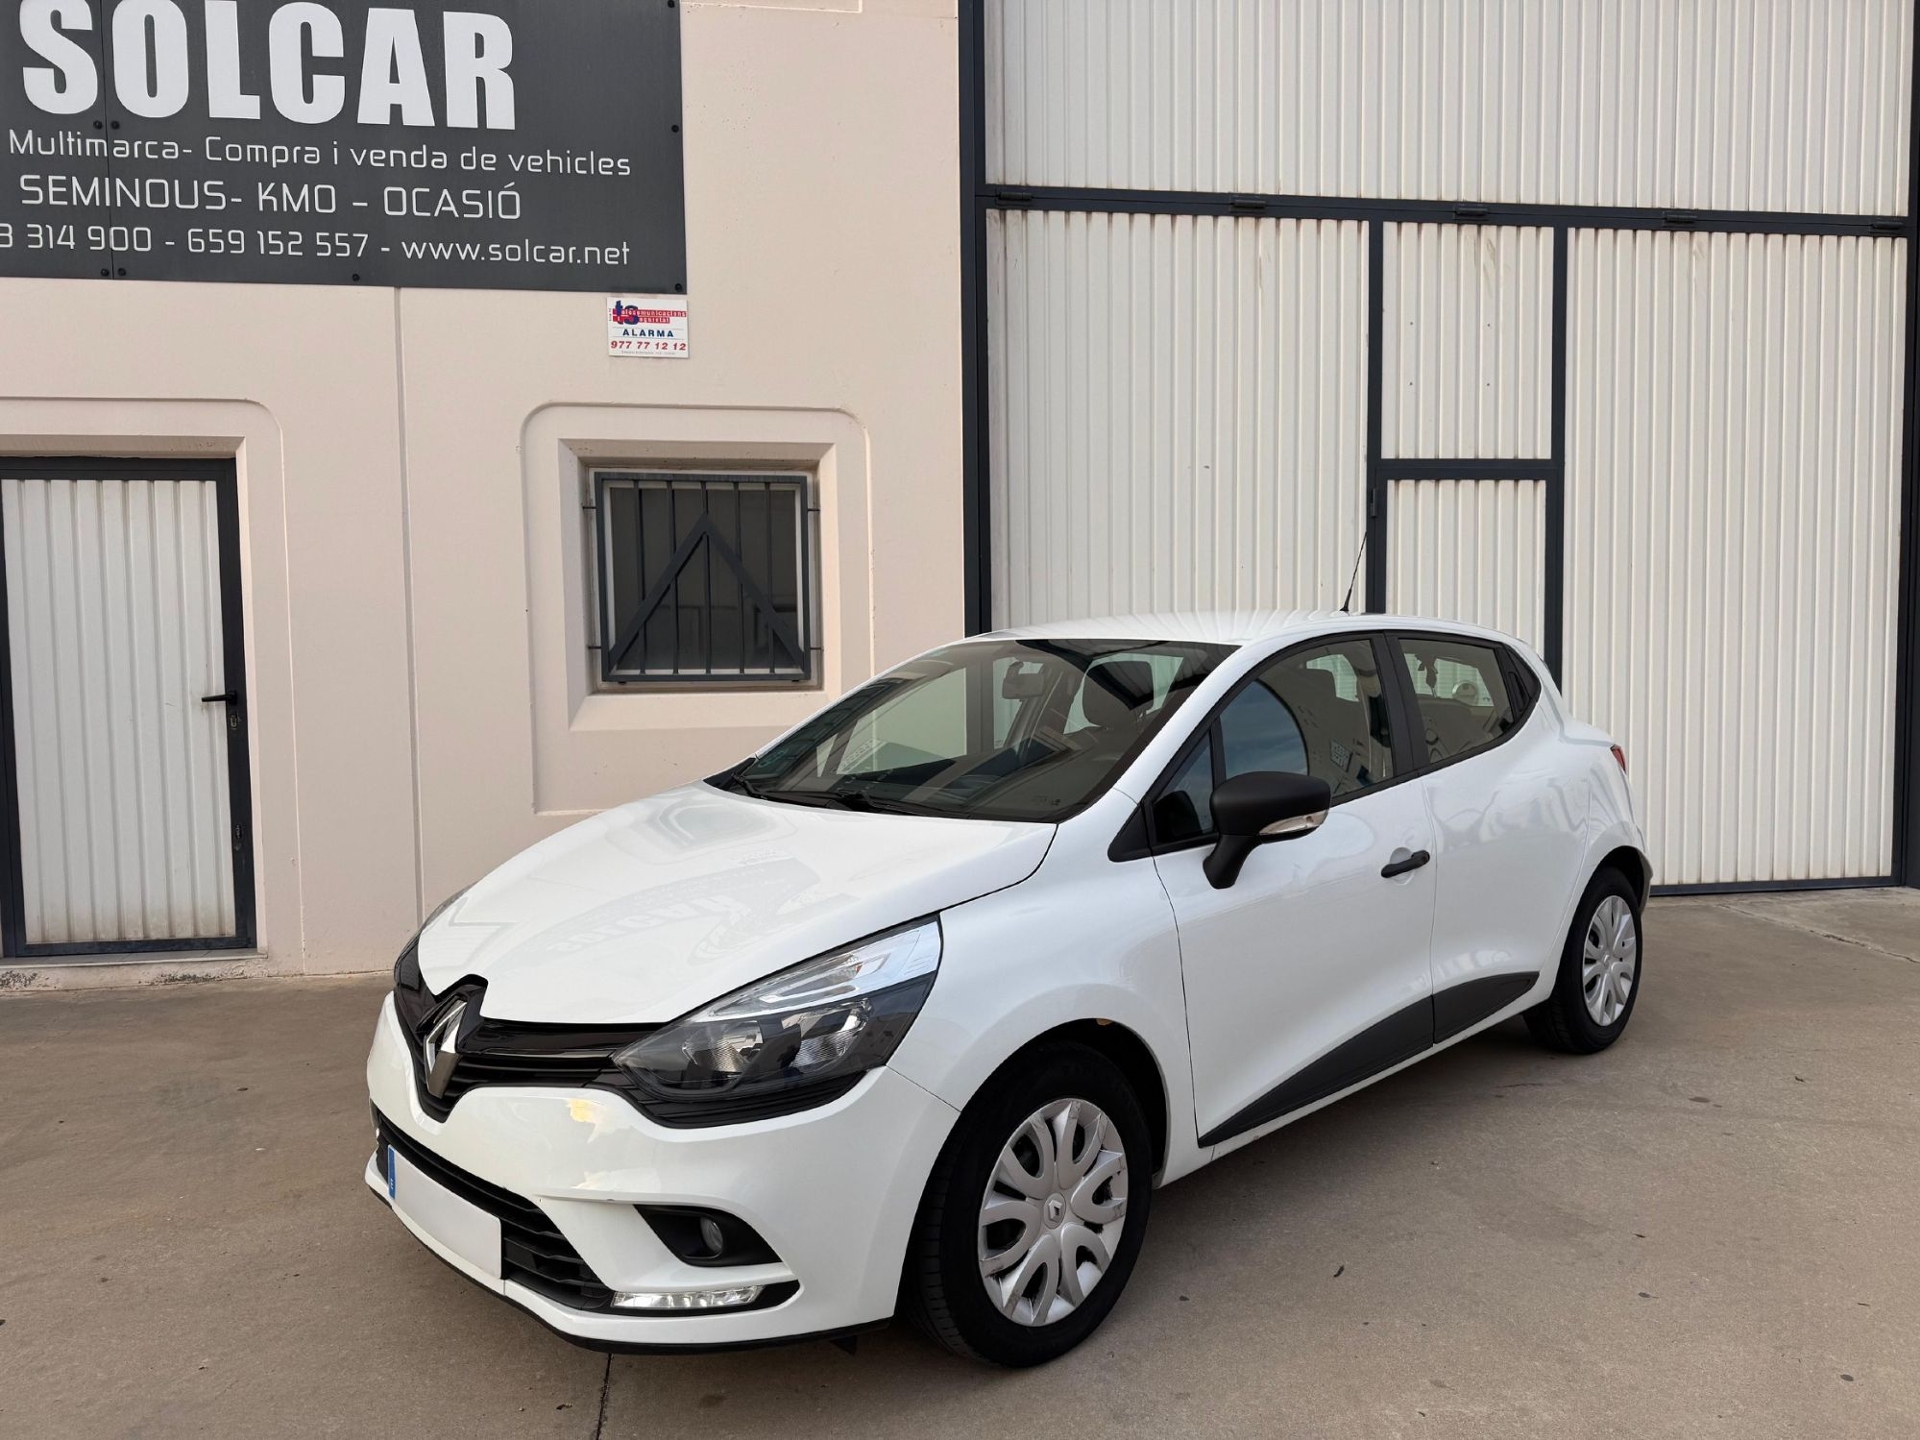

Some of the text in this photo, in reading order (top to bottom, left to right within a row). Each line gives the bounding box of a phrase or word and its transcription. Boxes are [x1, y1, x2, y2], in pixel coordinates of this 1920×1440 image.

[19, 0, 516, 130] SOLCAR
[9, 129, 631, 176] Multimarca- Compra i venda de vehicles
[20, 174, 242, 210] SEMINOUS-
[383, 182, 521, 220] OCASIÓ
[27, 224, 75, 250] 314
[88, 226, 152, 251] 900
[188, 228, 245, 253] 659
[257, 230, 303, 256] 152
[316, 232, 369, 258] 557
[401, 239, 630, 265] www.solcar.net
[611, 340, 687, 351] 977 77 12 12
[622, 328, 674, 337] ALARMA
